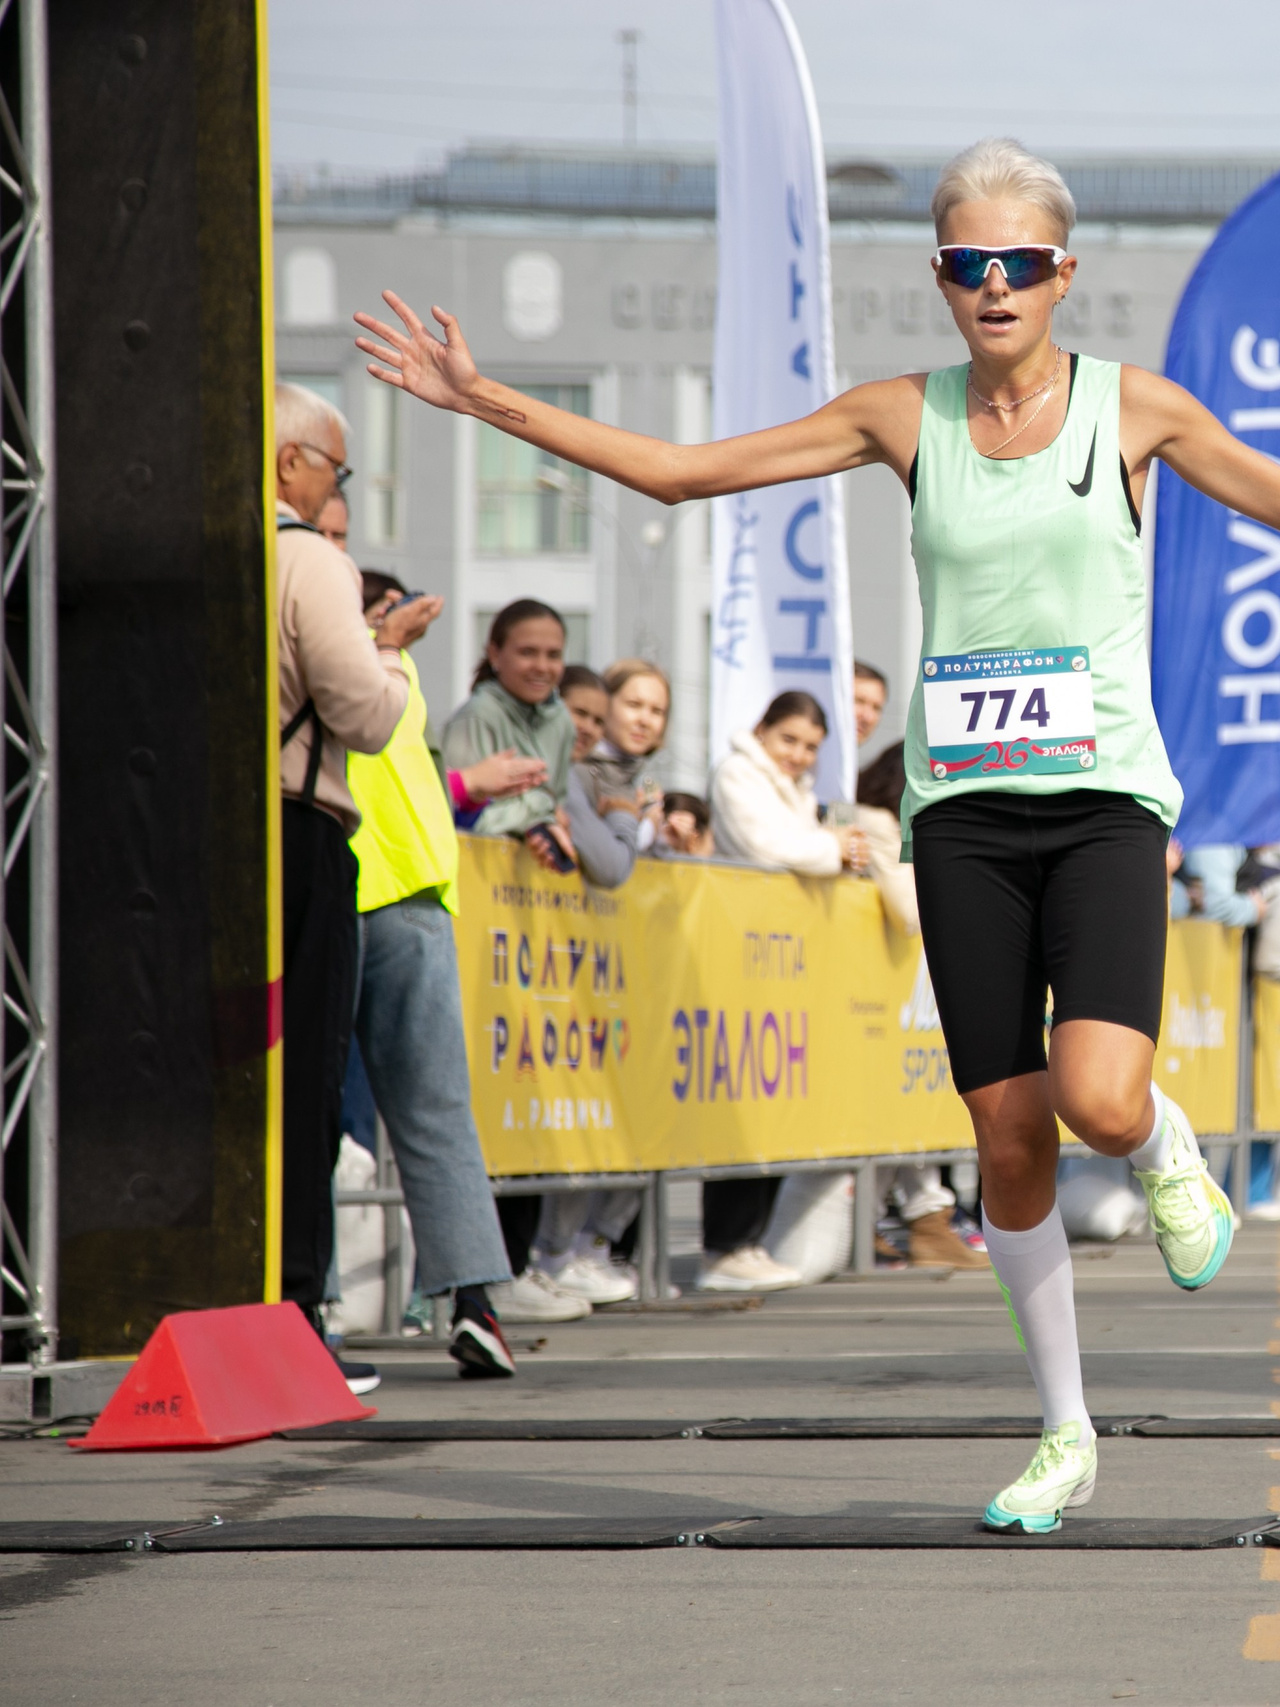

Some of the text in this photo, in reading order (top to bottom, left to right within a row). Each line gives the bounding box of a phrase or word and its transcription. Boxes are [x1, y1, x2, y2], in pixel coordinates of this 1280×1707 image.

[944, 655, 1054, 673] ПОЛУМАРАФОН
[960, 687, 1050, 732] 774
[982, 737, 1030, 772] 26
[1042, 744, 1089, 757] ЭТАЛОН
[672, 1007, 808, 1103] ЭТАЛОН
